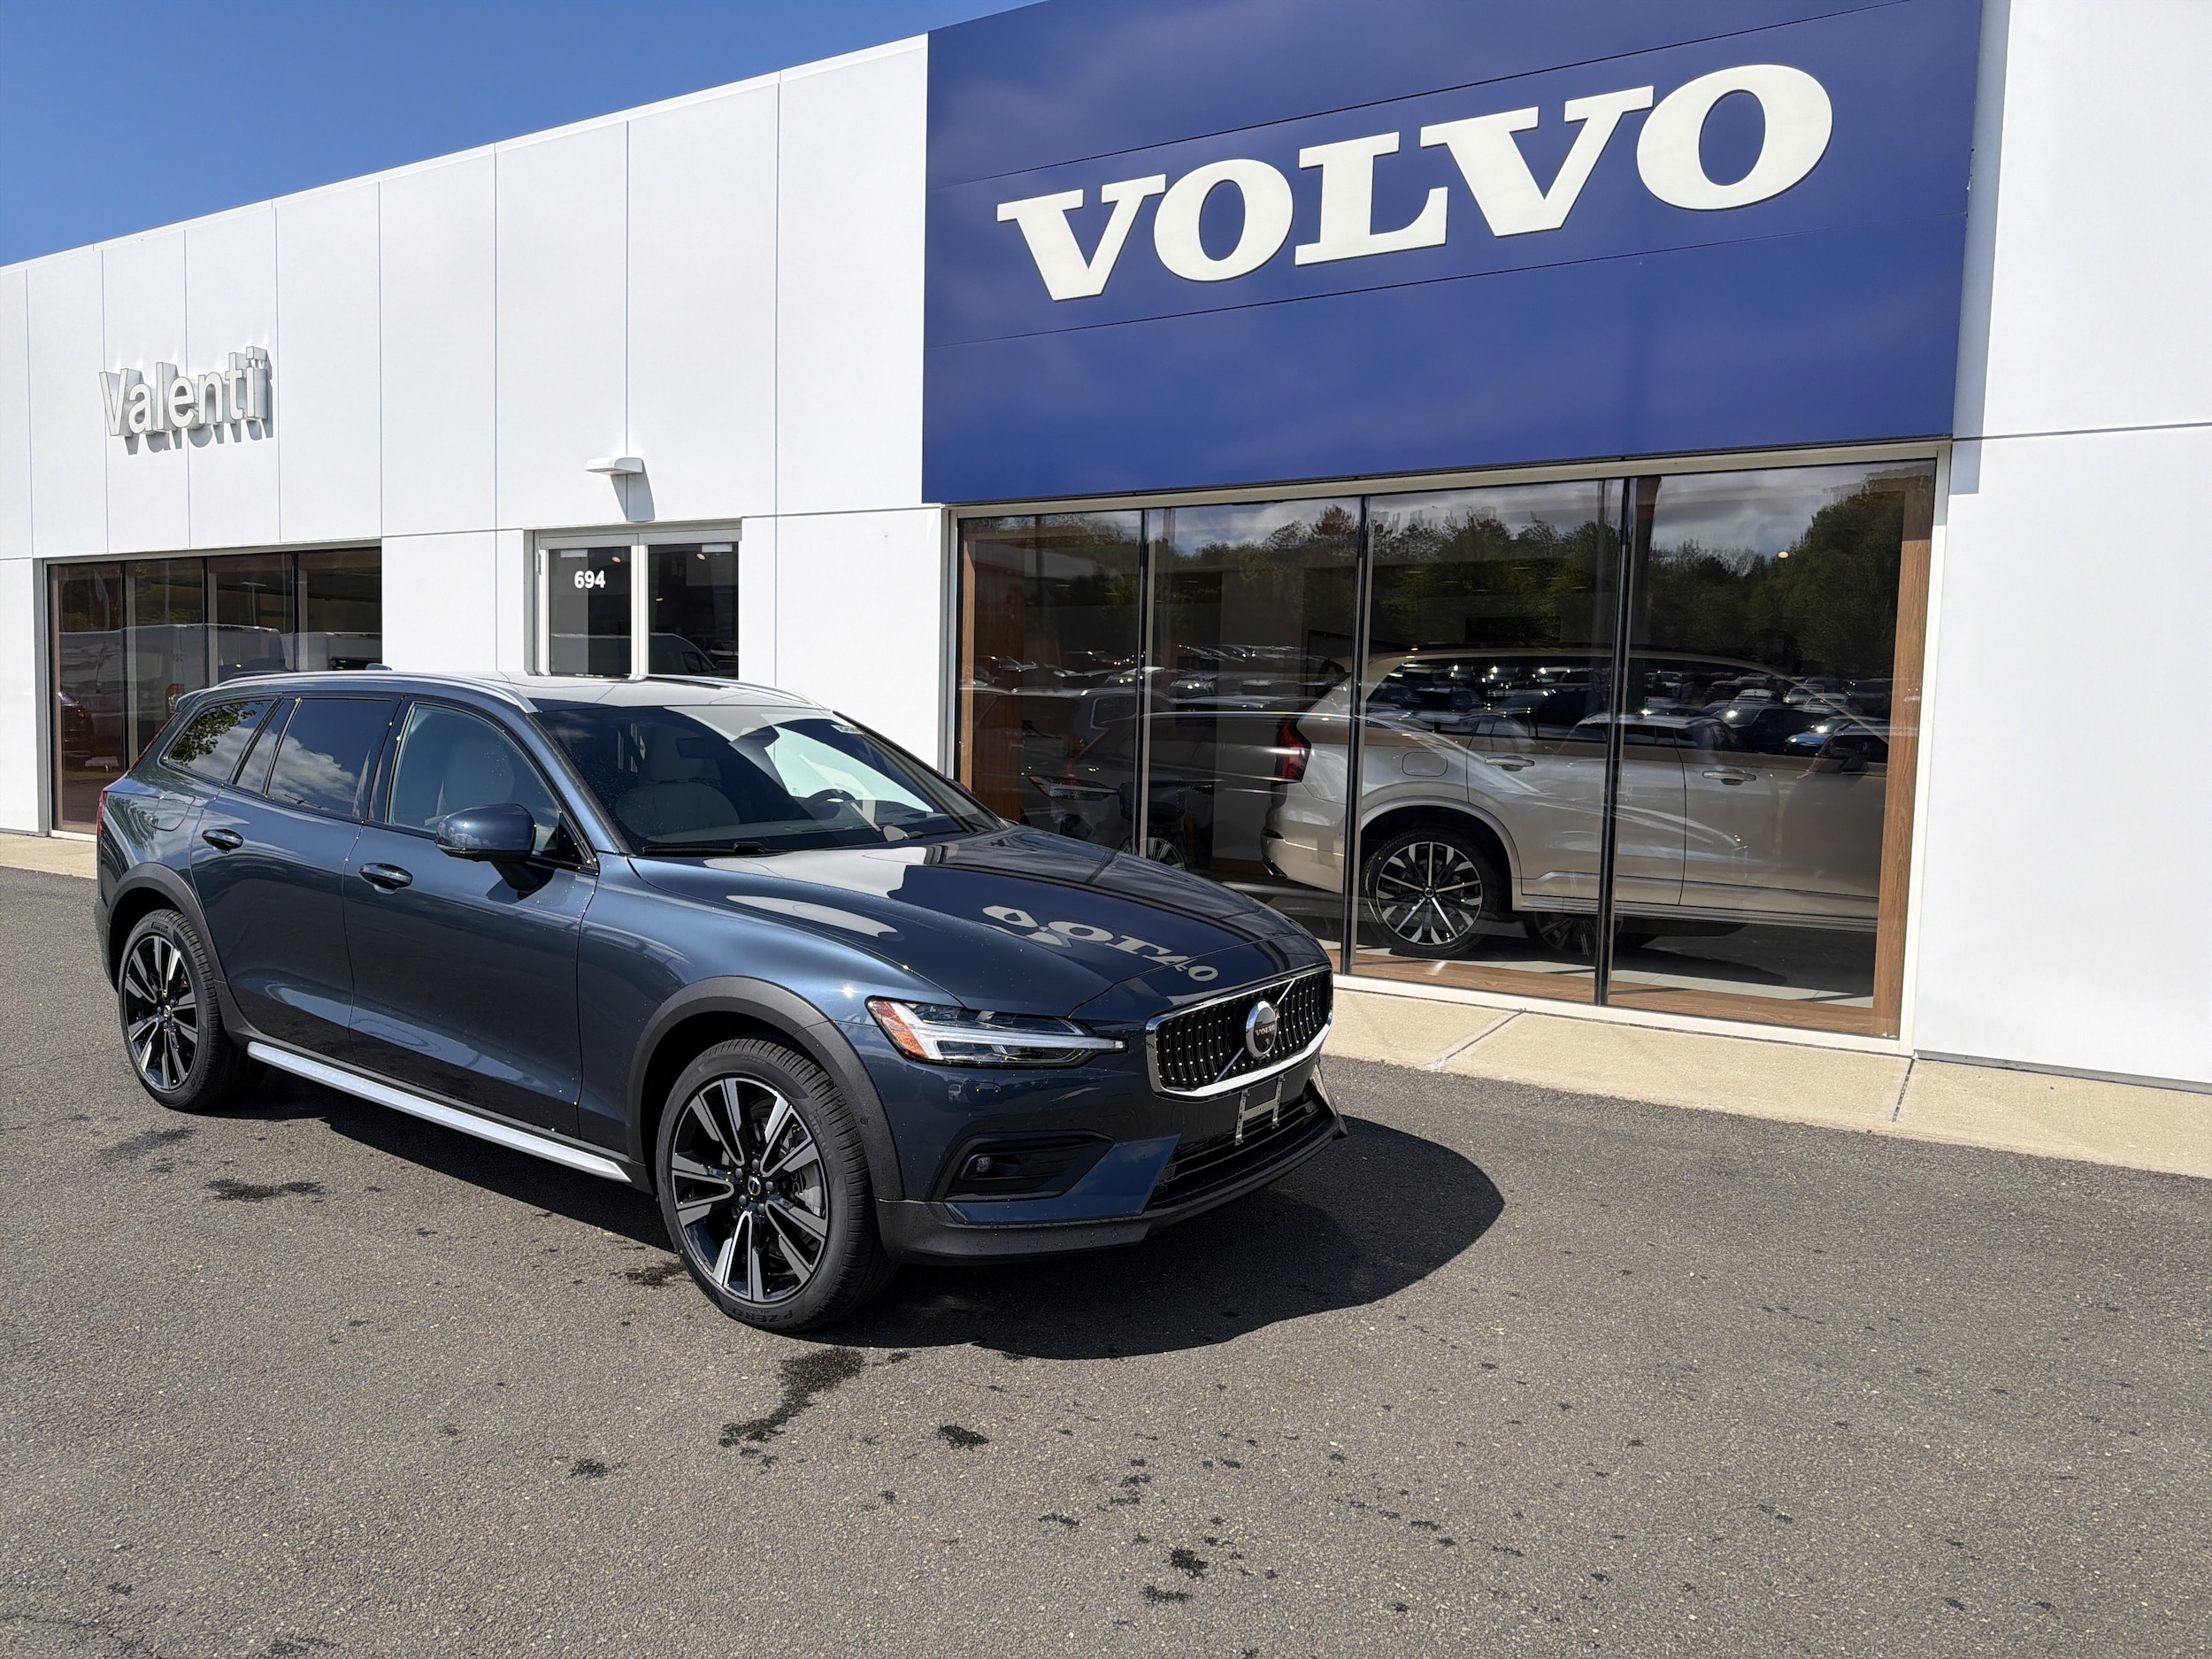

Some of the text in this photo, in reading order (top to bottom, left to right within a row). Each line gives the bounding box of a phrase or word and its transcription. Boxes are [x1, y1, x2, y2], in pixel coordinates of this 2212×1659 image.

[997, 65, 1832, 301] VOLVO
[98, 346, 268, 437] Valenti
[574, 570, 606, 589] 694
